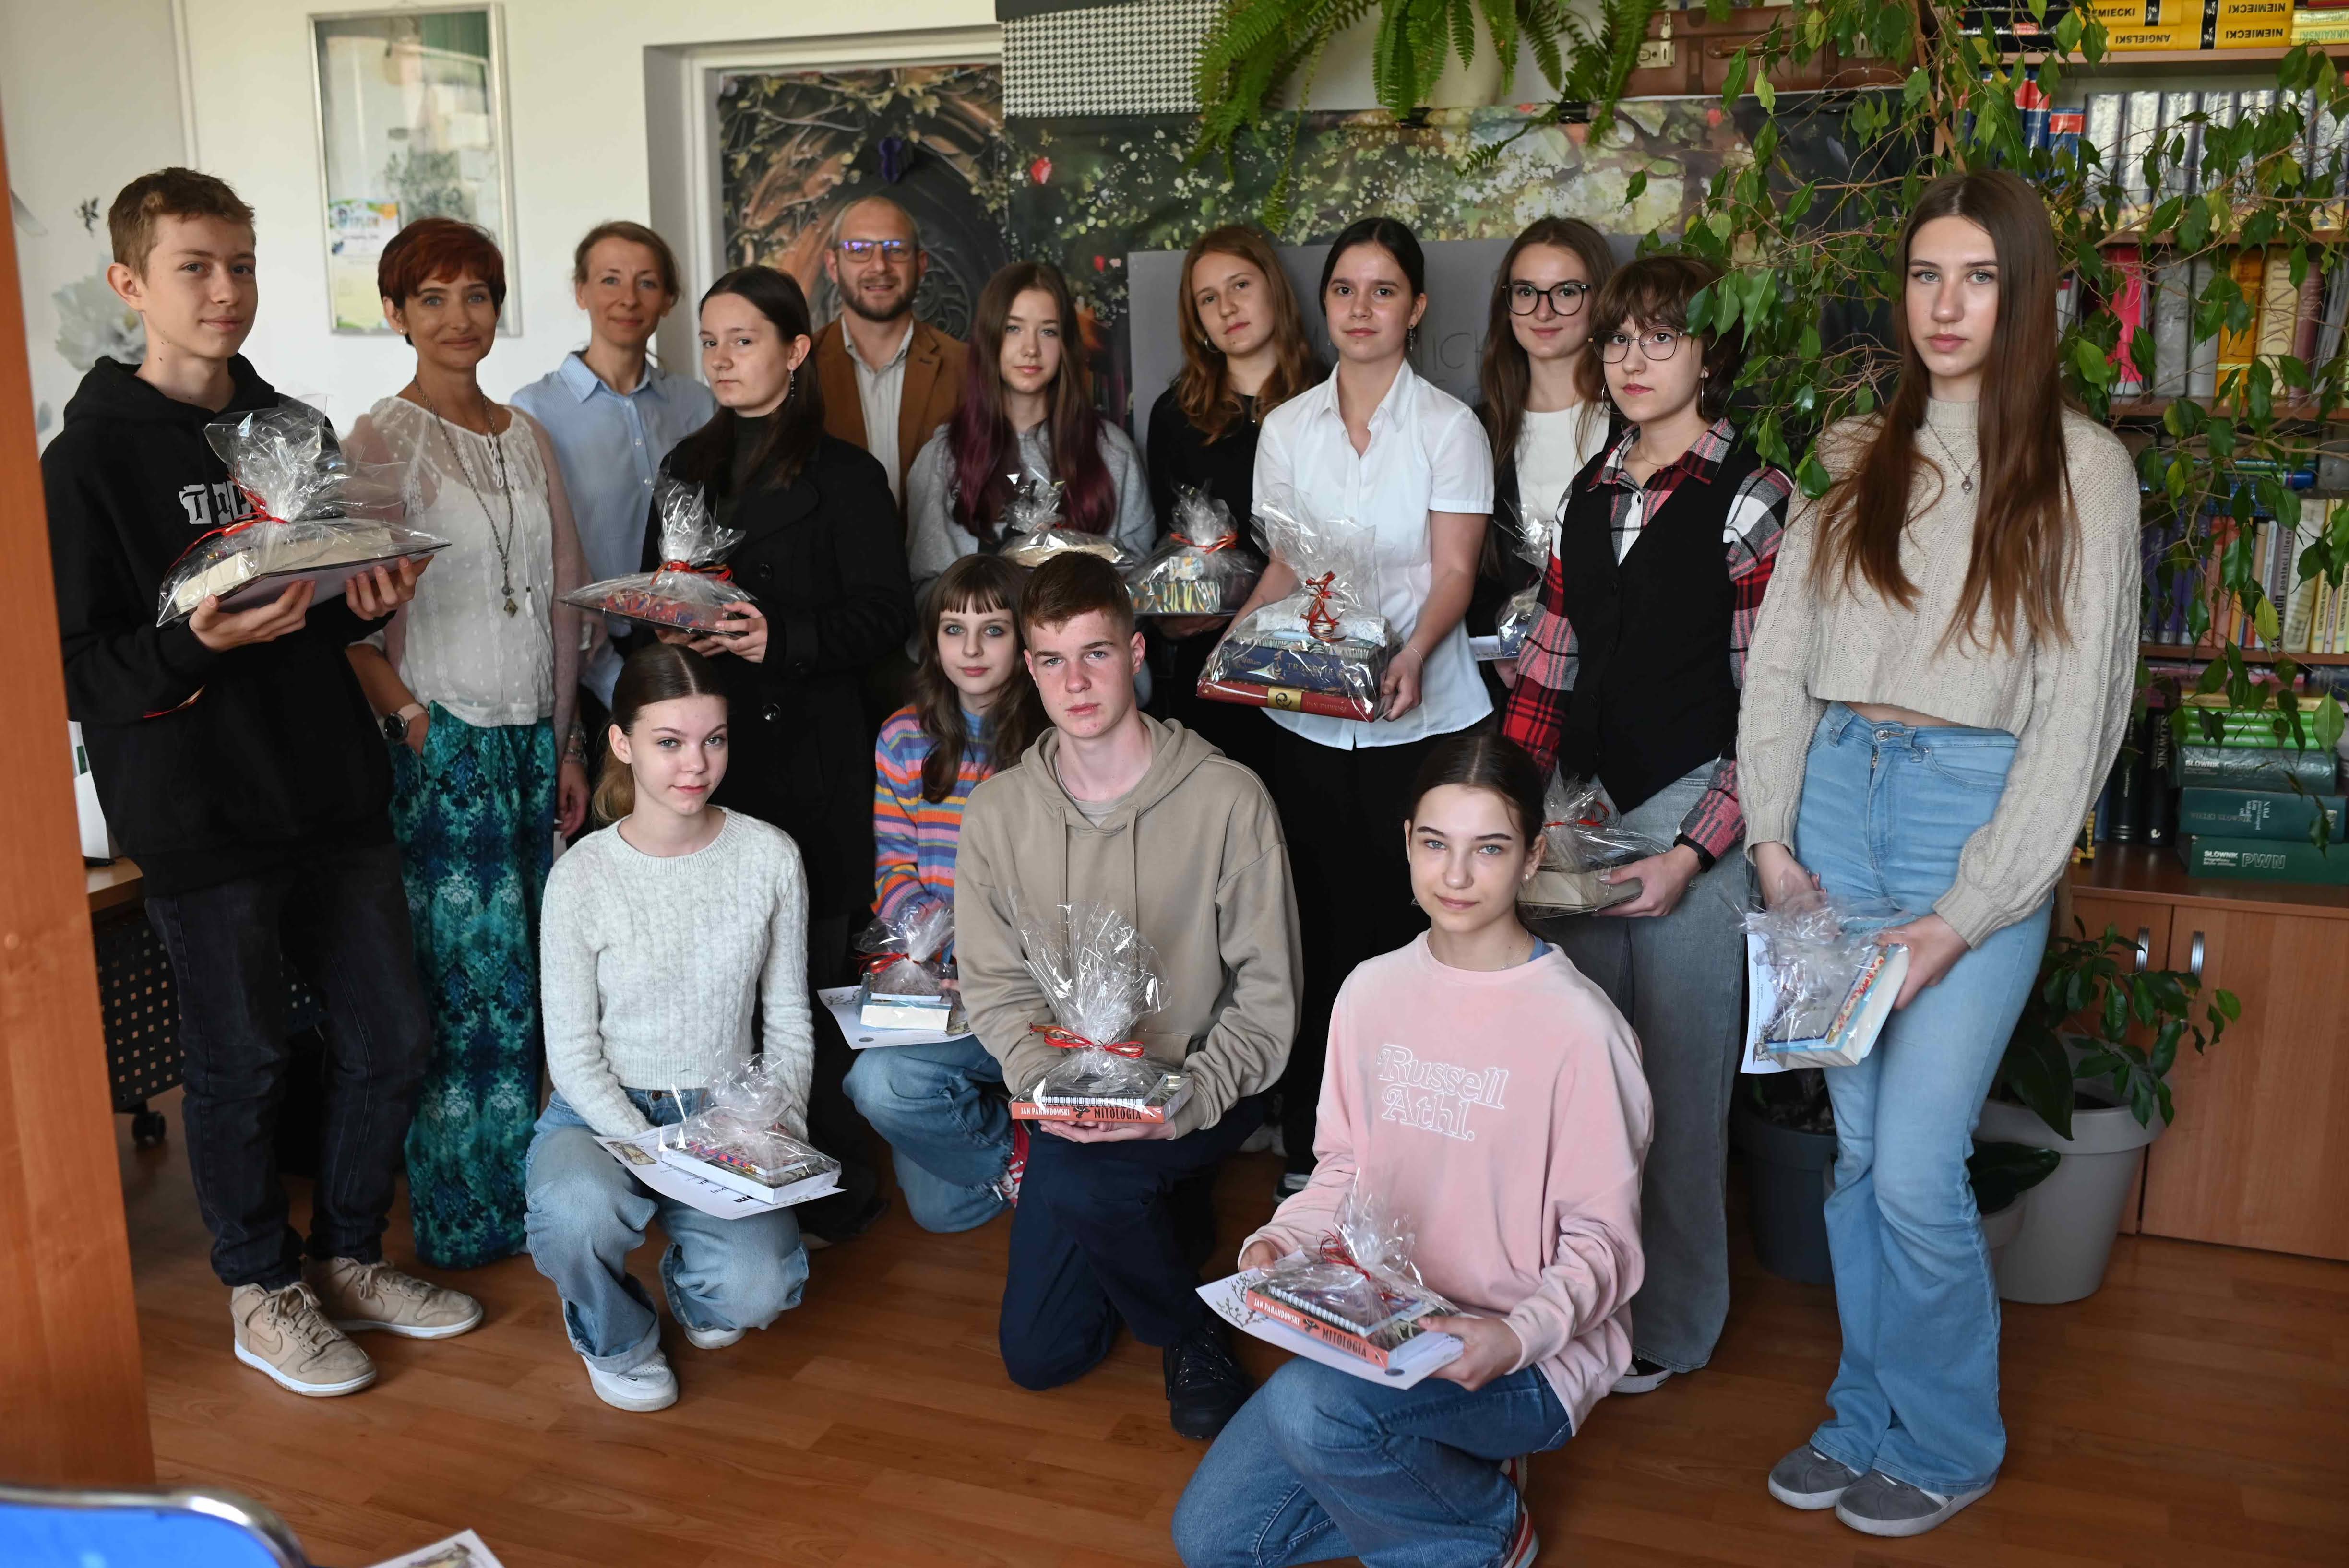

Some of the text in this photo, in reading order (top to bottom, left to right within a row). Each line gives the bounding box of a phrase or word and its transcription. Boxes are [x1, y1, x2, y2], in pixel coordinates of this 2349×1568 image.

[2088, 7, 2135, 18] MIECKI
[2228, 3, 2286, 14] NIEMIECKI
[2115, 34, 2170, 44] ANGIELSKI
[2225, 28, 2283, 39] NIEMIECKI
[2283, 531, 2292, 554] litera
[2280, 558, 2289, 591] postaci
[2242, 852, 2287, 869] PWN
[1376, 1043, 1509, 1110] Russell
[1021, 1107, 1142, 1120] JAN PARANDOWSKI MITOLOGIA
[1381, 1082, 1475, 1141] Athl.
[1254, 1297, 1367, 1358] JAN PARANDOWSKI MITOLOGIA
